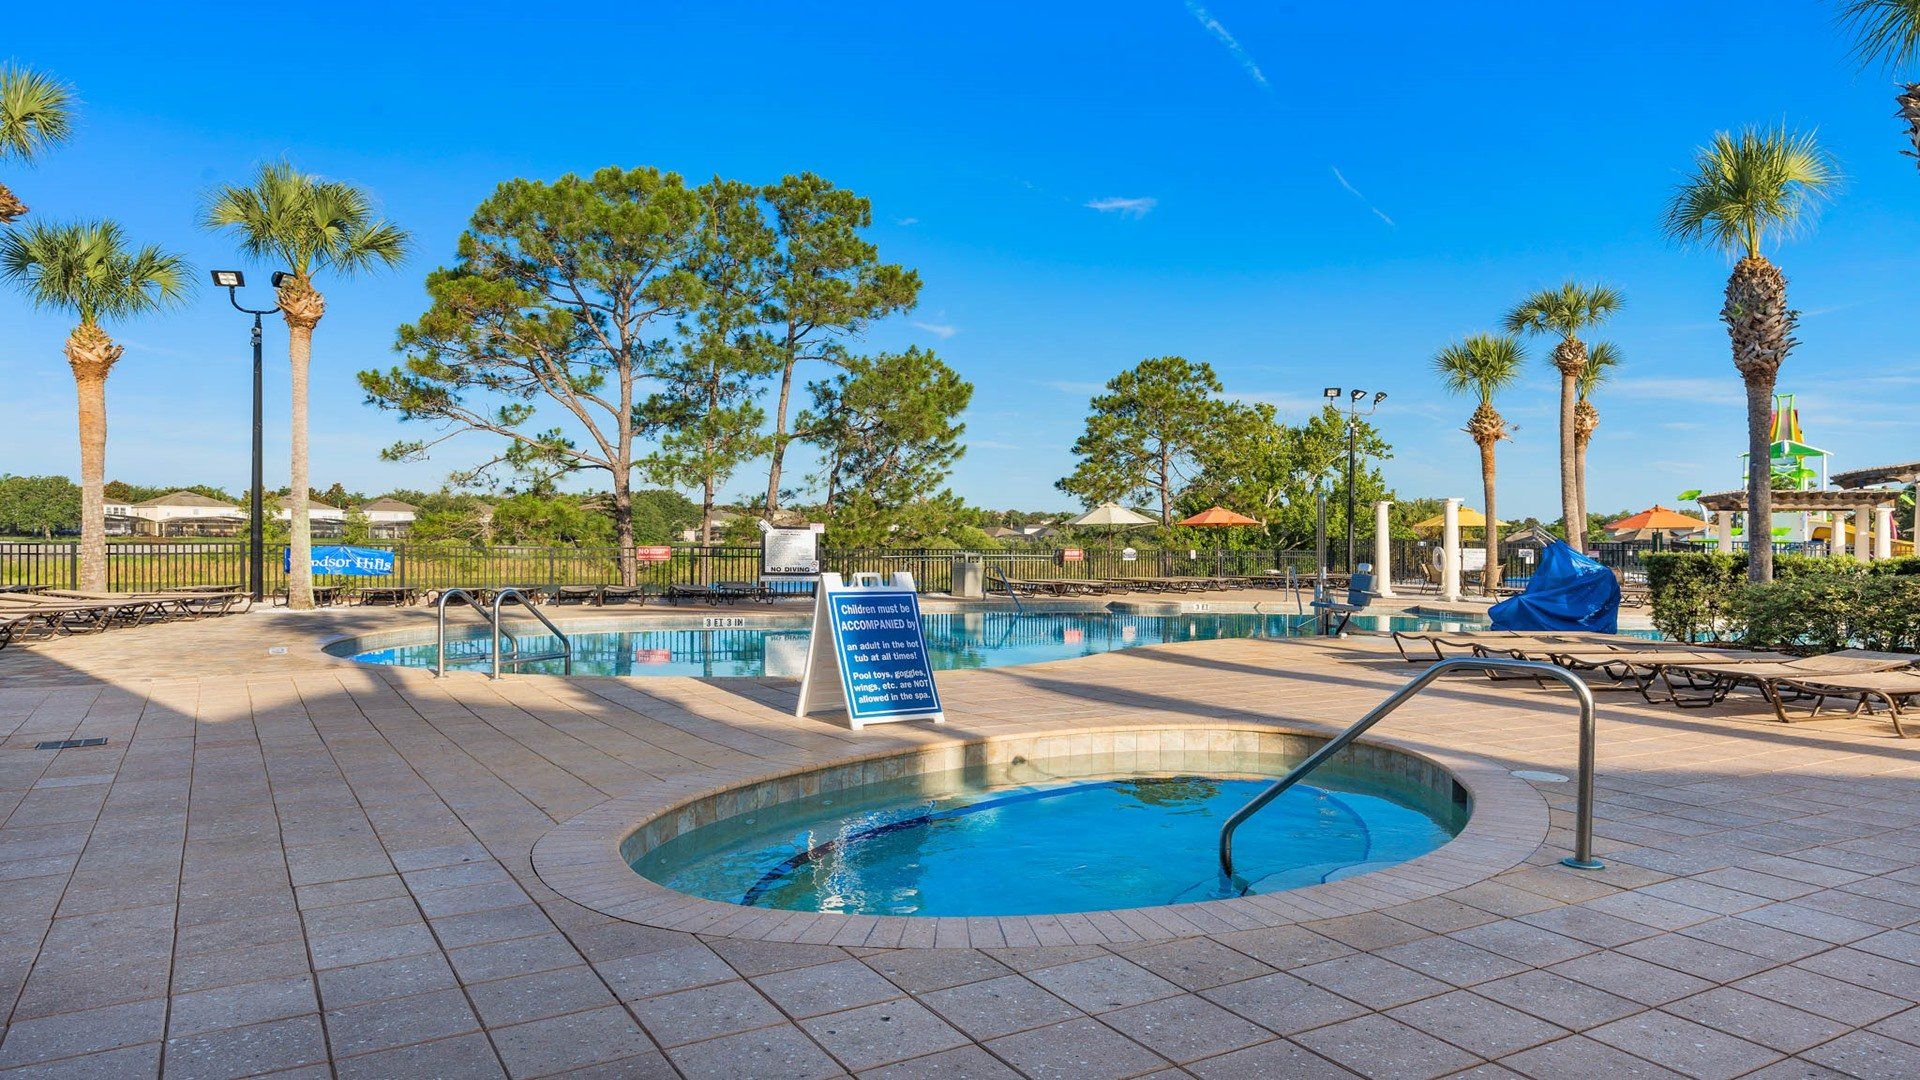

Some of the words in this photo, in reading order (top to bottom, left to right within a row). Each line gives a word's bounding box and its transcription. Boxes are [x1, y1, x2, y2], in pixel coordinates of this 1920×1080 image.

[288, 555, 352, 568] ndsor
[841, 604, 876, 615] Children
[877, 604, 899, 614] must
[899, 603, 910, 613] be
[706, 618, 711, 627] 3
[727, 618, 732, 627] 3
[734, 618, 743, 627] IN
[841, 619, 905, 631] ACCOMPANIED
[906, 619, 916, 631] by
[860, 641, 880, 650] adult
[882, 640, 890, 649] in
[891, 641, 905, 649] the
[906, 640, 919, 648] hot
[854, 654, 868, 662] tub
[870, 653, 880, 661] at
[881, 653, 892, 661] all
[893, 651, 917, 660] times!
[852, 671, 871, 680] Pool
[872, 670, 893, 680] toys,
[894, 669, 926, 679] goggles,
[853, 683, 881, 692] wings,
[913, 679, 929, 688] NOT
[858, 693, 889, 704] allowed
[890, 693, 898, 701] in
[900, 692, 913, 700] the
[914, 692, 931, 700] spa.
